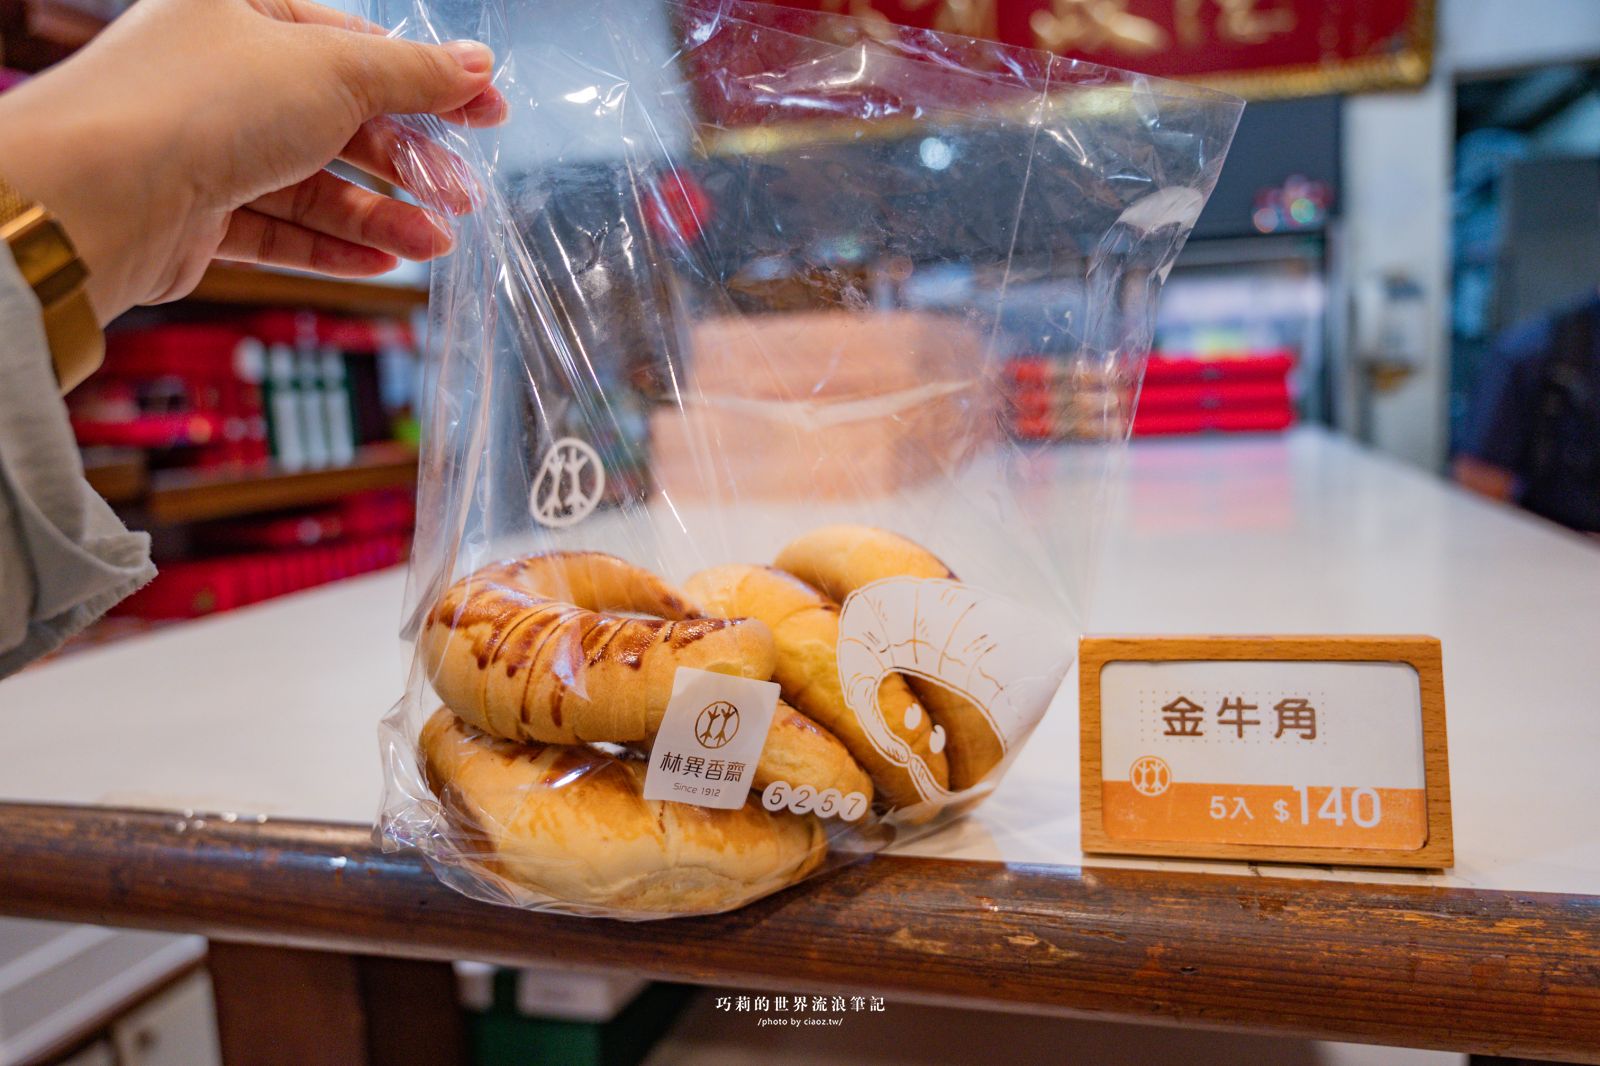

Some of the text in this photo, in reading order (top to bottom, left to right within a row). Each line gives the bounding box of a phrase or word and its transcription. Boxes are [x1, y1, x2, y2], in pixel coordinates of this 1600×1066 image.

[1161, 696, 1318, 740] 金牛角
[659, 751, 746, 783] 林異香齋
[673, 782, 721, 797] Since 1912
[1209, 785, 1382, 829] 5入 $140
